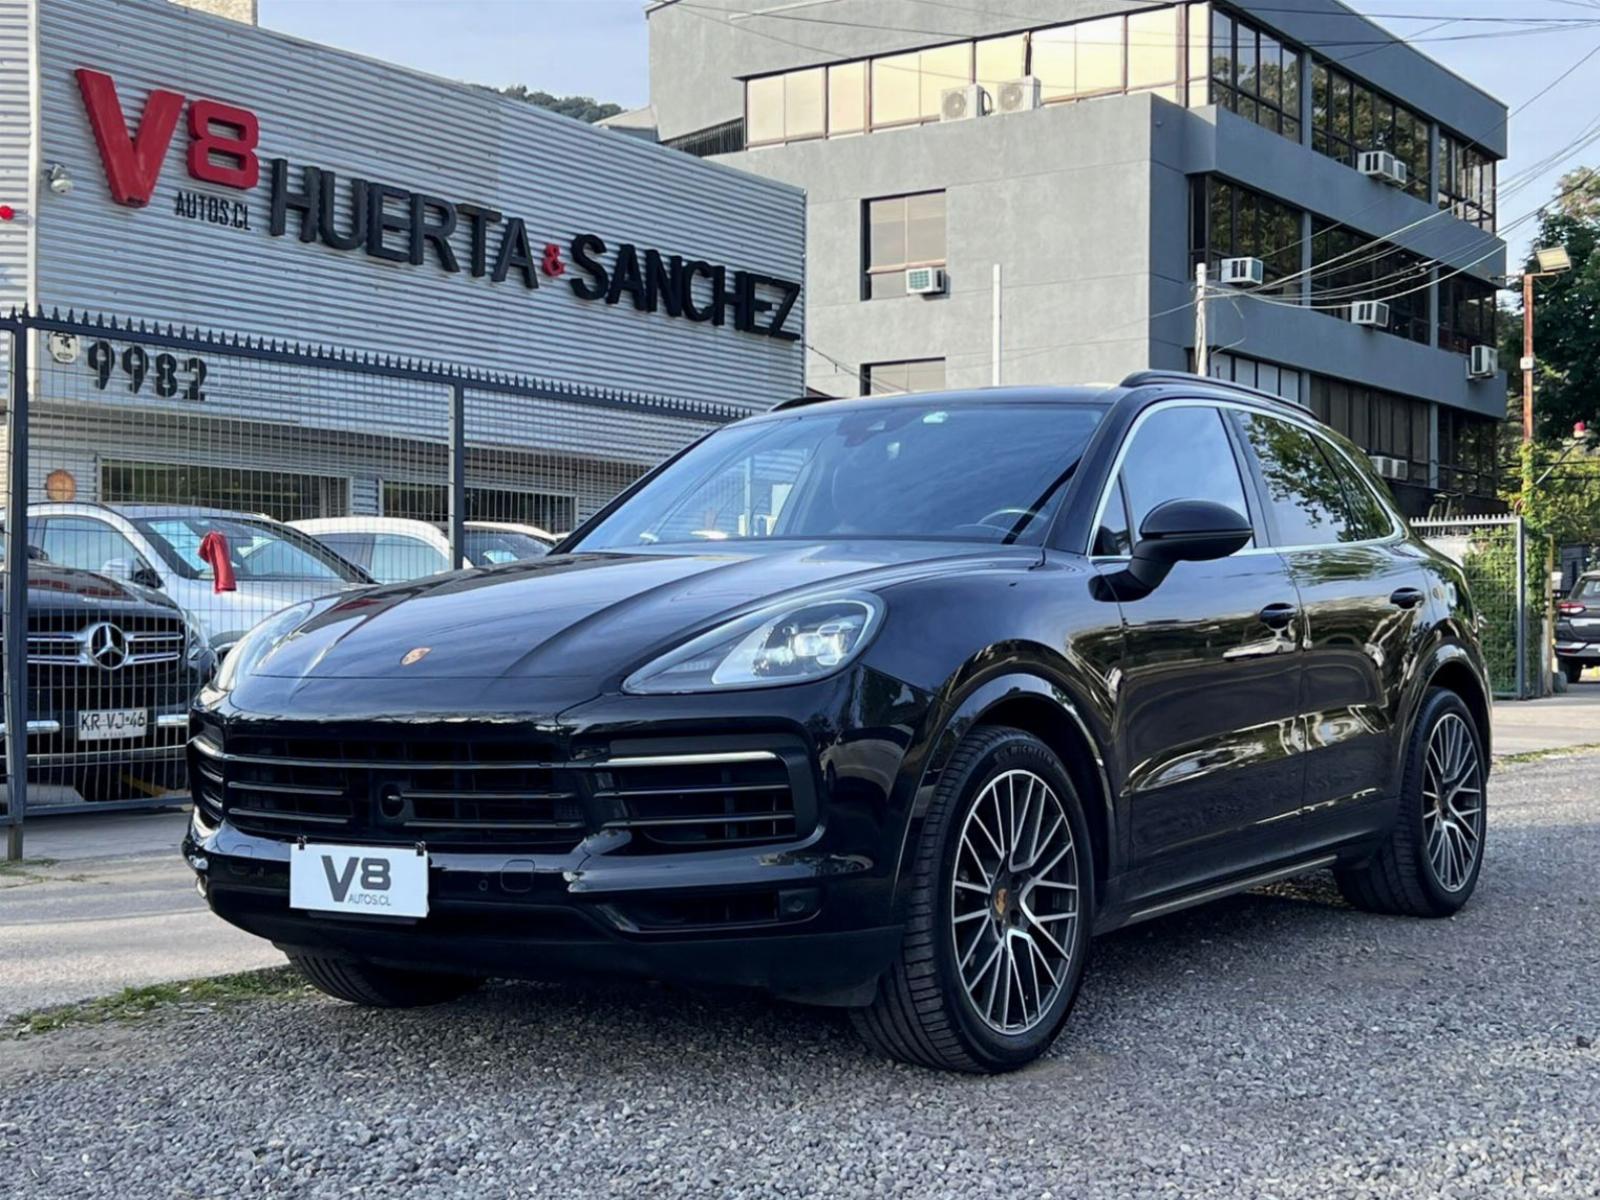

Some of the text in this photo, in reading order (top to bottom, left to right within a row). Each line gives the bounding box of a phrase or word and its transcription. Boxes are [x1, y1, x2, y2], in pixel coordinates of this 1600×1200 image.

[75, 68, 259, 208] V8
[174, 191, 251, 230] AUTOS.CL
[270, 158, 801, 341] HUERTA & SANCHEZ
[87, 340, 207, 401] 9982
[321, 855, 391, 902] V8
[347, 893, 391, 906] AUTOS.CL
